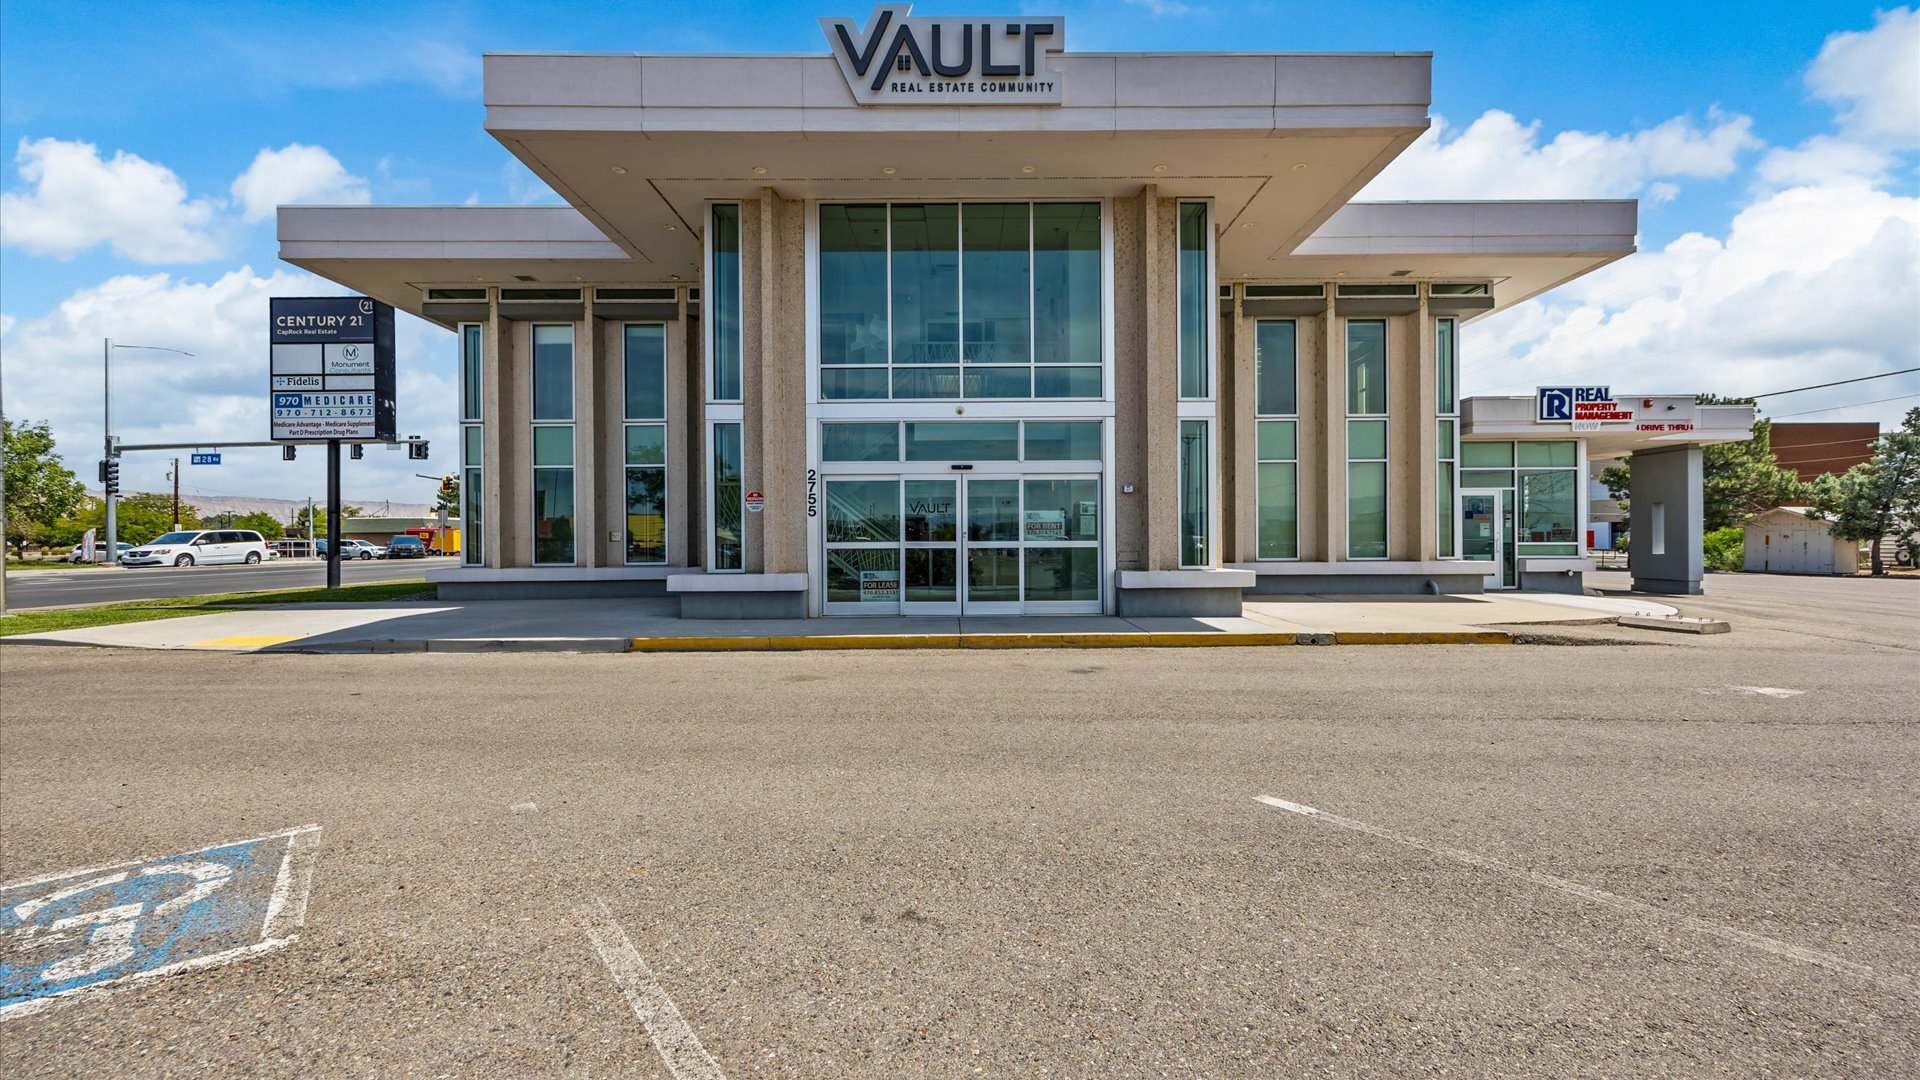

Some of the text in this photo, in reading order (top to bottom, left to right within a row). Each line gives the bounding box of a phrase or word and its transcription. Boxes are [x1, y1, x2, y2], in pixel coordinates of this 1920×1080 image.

[834, 10, 1054, 91] VAULT
[891, 82, 1054, 93] REAL ESTATE COMMUNITY
[276, 315, 363, 327] CENTURY 21
[276, 328, 302, 336] CapRock
[345, 348, 357, 357] M
[286, 377, 320, 386] Fidelis
[1575, 388, 1613, 401] REAL
[278, 395, 372, 406] 970 MEDICARE
[1575, 403, 1618, 411] PROPERTY
[276, 408, 373, 417] 970-712-8672
[1575, 412, 1633, 420] MANAGEMENT
[296, 421, 322, 429] Advantage
[304, 429, 333, 437] Prescription
[807, 469, 817, 517] 2755
[909, 501, 951, 515] VAULT
